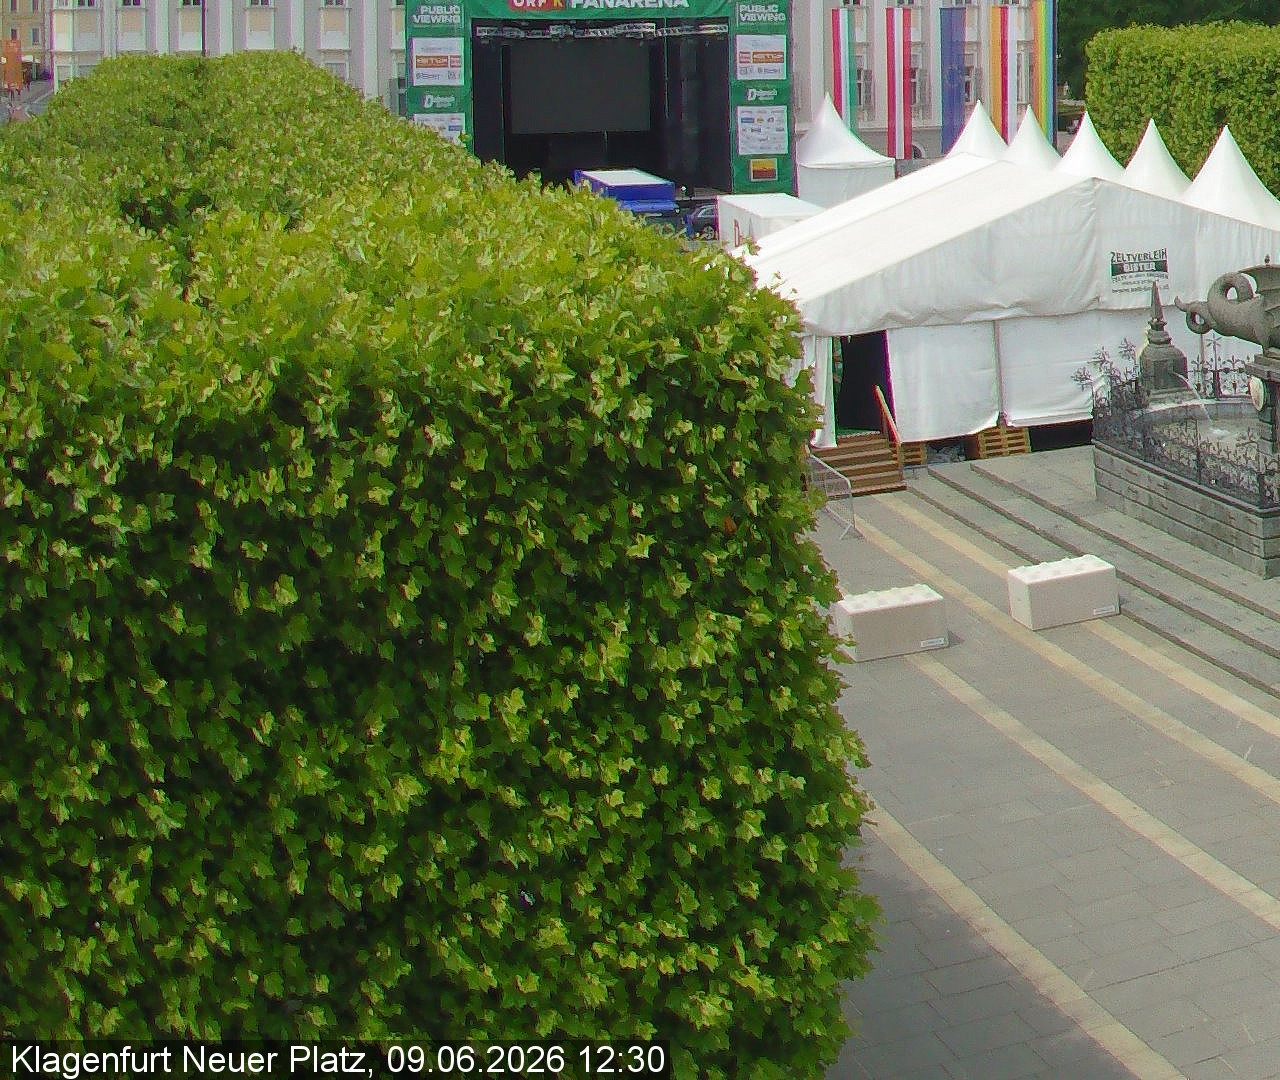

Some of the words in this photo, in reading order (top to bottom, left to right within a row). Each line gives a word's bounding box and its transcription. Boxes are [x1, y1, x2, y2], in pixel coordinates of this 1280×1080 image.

[420, 5, 461, 14] PUBLIC
[740, 4, 779, 13] PUBLIC
[412, 14, 461, 24] VIEWING
[740, 13, 786, 22] VIEWING
[1110, 248, 1168, 263] ZELTVERLEIH
